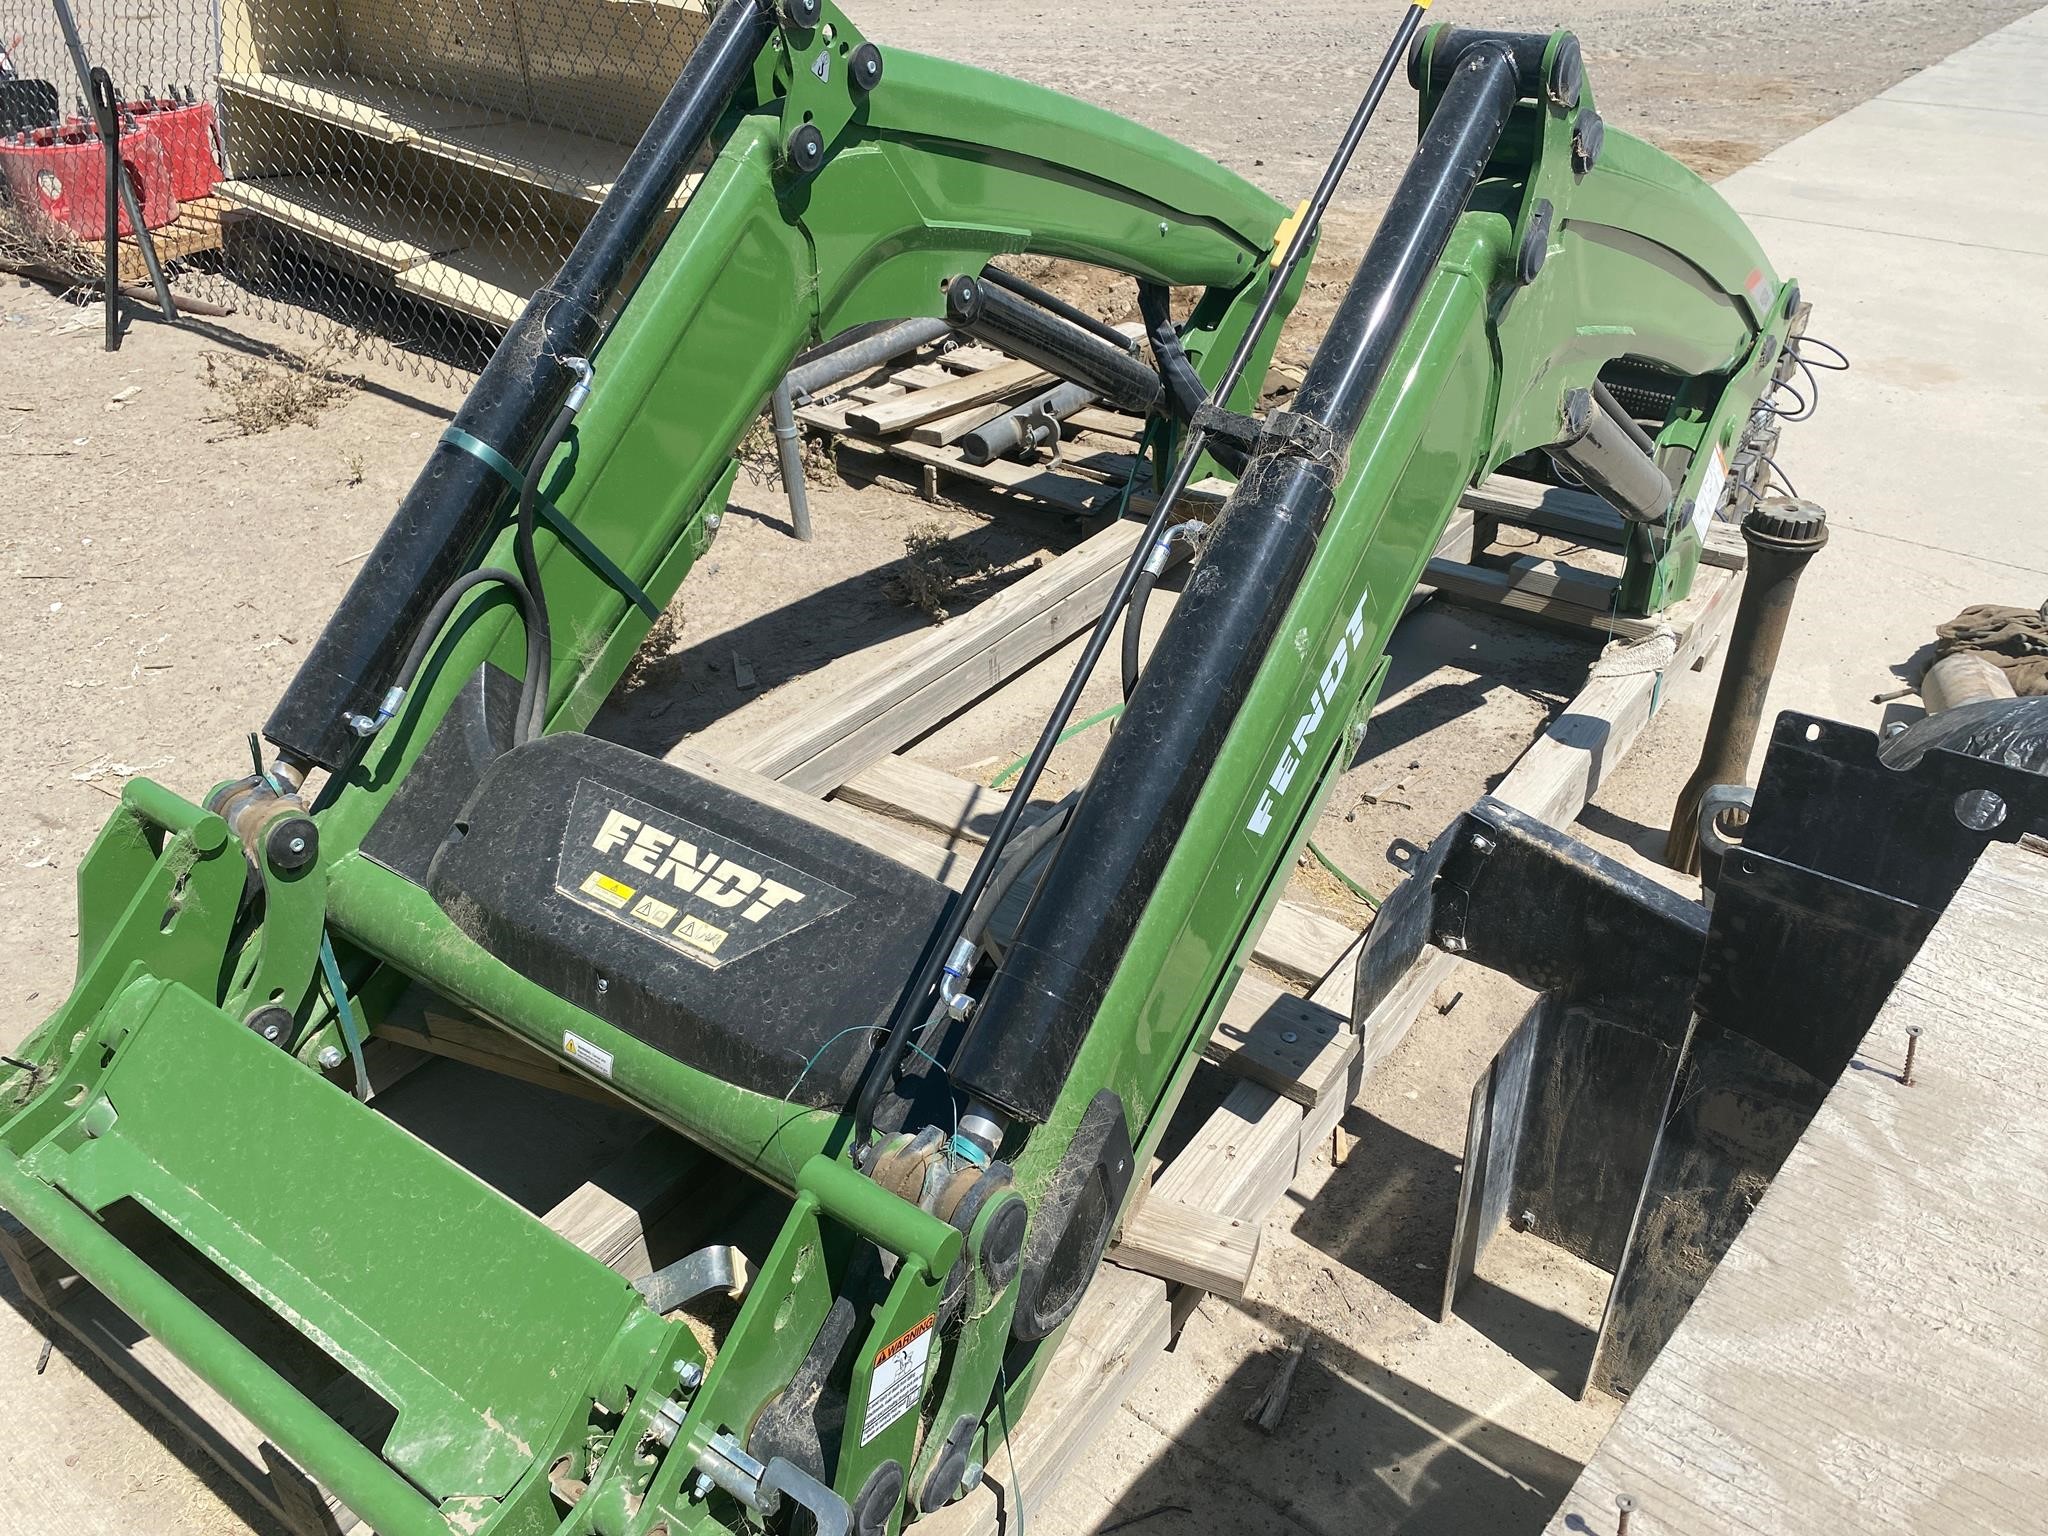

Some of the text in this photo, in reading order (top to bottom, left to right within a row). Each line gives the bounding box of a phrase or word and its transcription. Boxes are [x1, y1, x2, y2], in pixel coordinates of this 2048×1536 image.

[1246, 588, 1368, 836] FENDT
[591, 808, 806, 923] FENDT
[887, 1317, 933, 1357] WARNING
